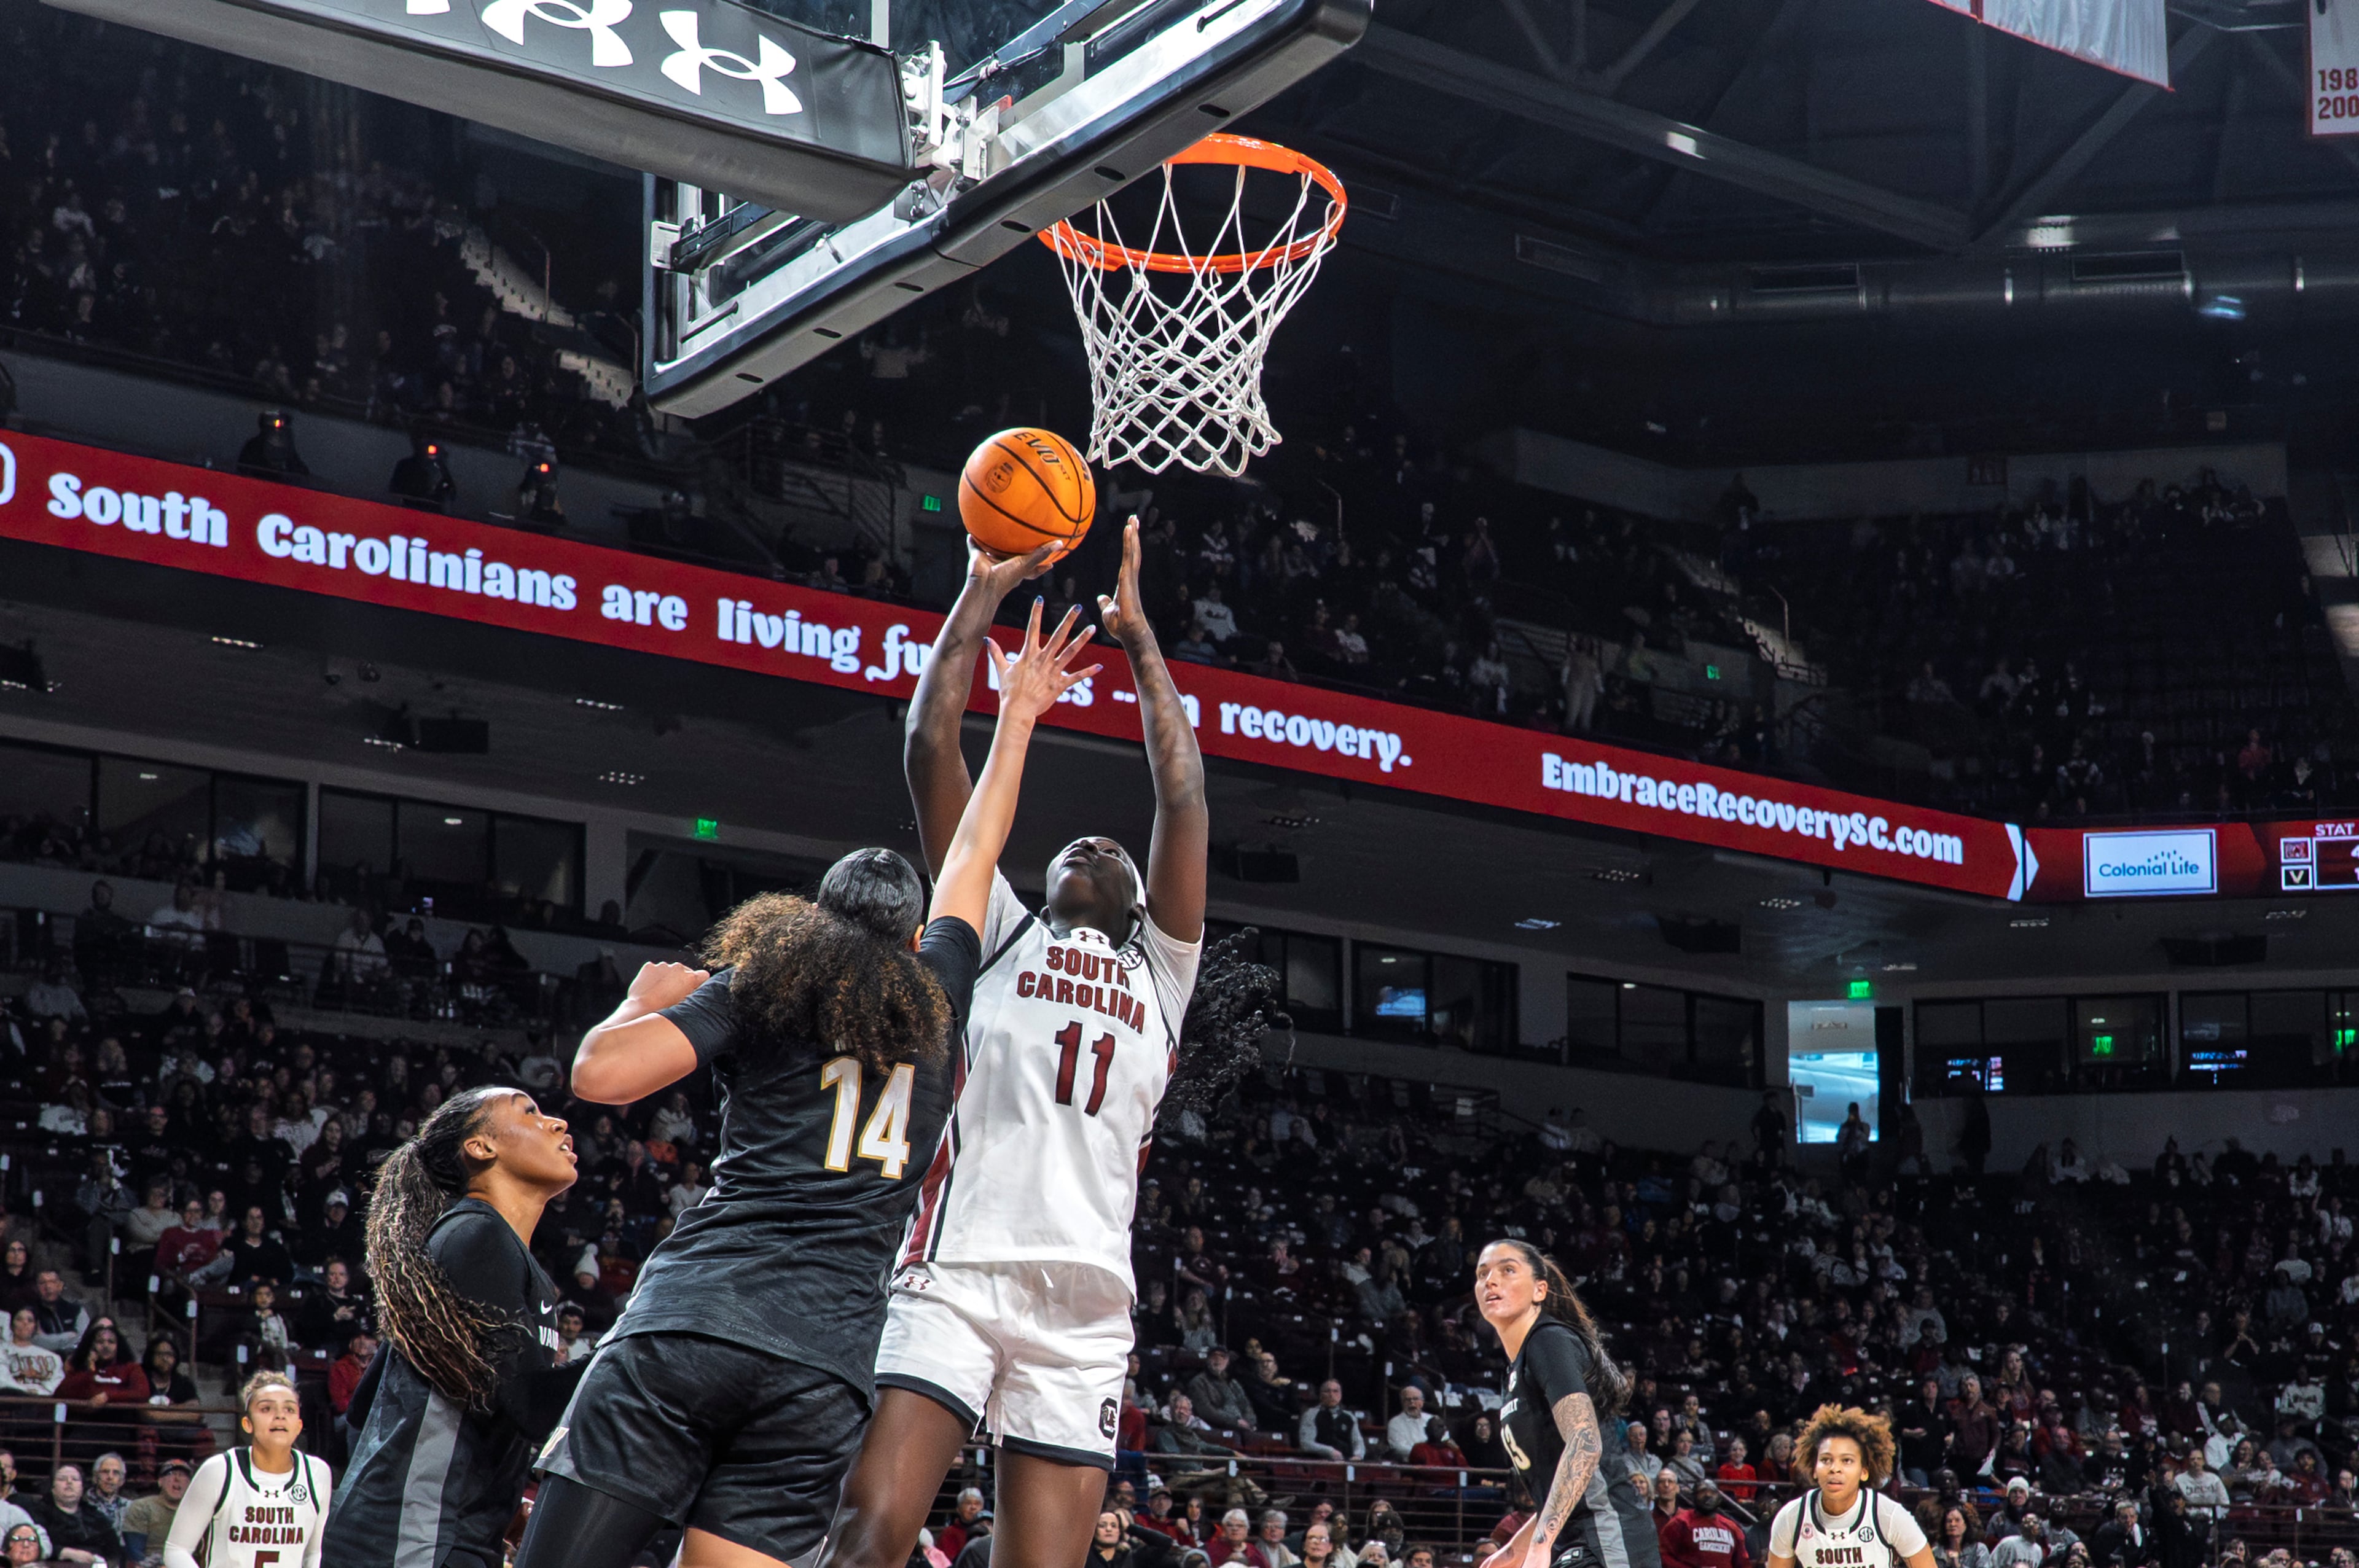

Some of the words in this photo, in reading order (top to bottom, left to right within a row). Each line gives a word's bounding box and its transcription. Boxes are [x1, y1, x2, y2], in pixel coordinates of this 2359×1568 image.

[47, 472, 227, 546] South
[257, 513, 577, 610] Carolinians
[601, 584, 687, 630] are
[718, 598, 861, 673] living
[1220, 702, 1412, 772] recovery.
[1541, 752, 1963, 864] EmbraceRecoverySC.com
[2315, 823, 2355, 836] STAT
[2099, 862, 2167, 877] Colonial
[2172, 856, 2199, 875] Life
[1046, 946, 1130, 991] SOUTH
[1017, 971, 1145, 1034] CAROLINA
[1054, 1020, 1116, 1117] 11
[820, 1056, 915, 1179] 14
[229, 1526, 304, 1544] CAROLINA
[245, 1506, 295, 1524] SOUTH
[1815, 1547, 1863, 1565] SOUTH
